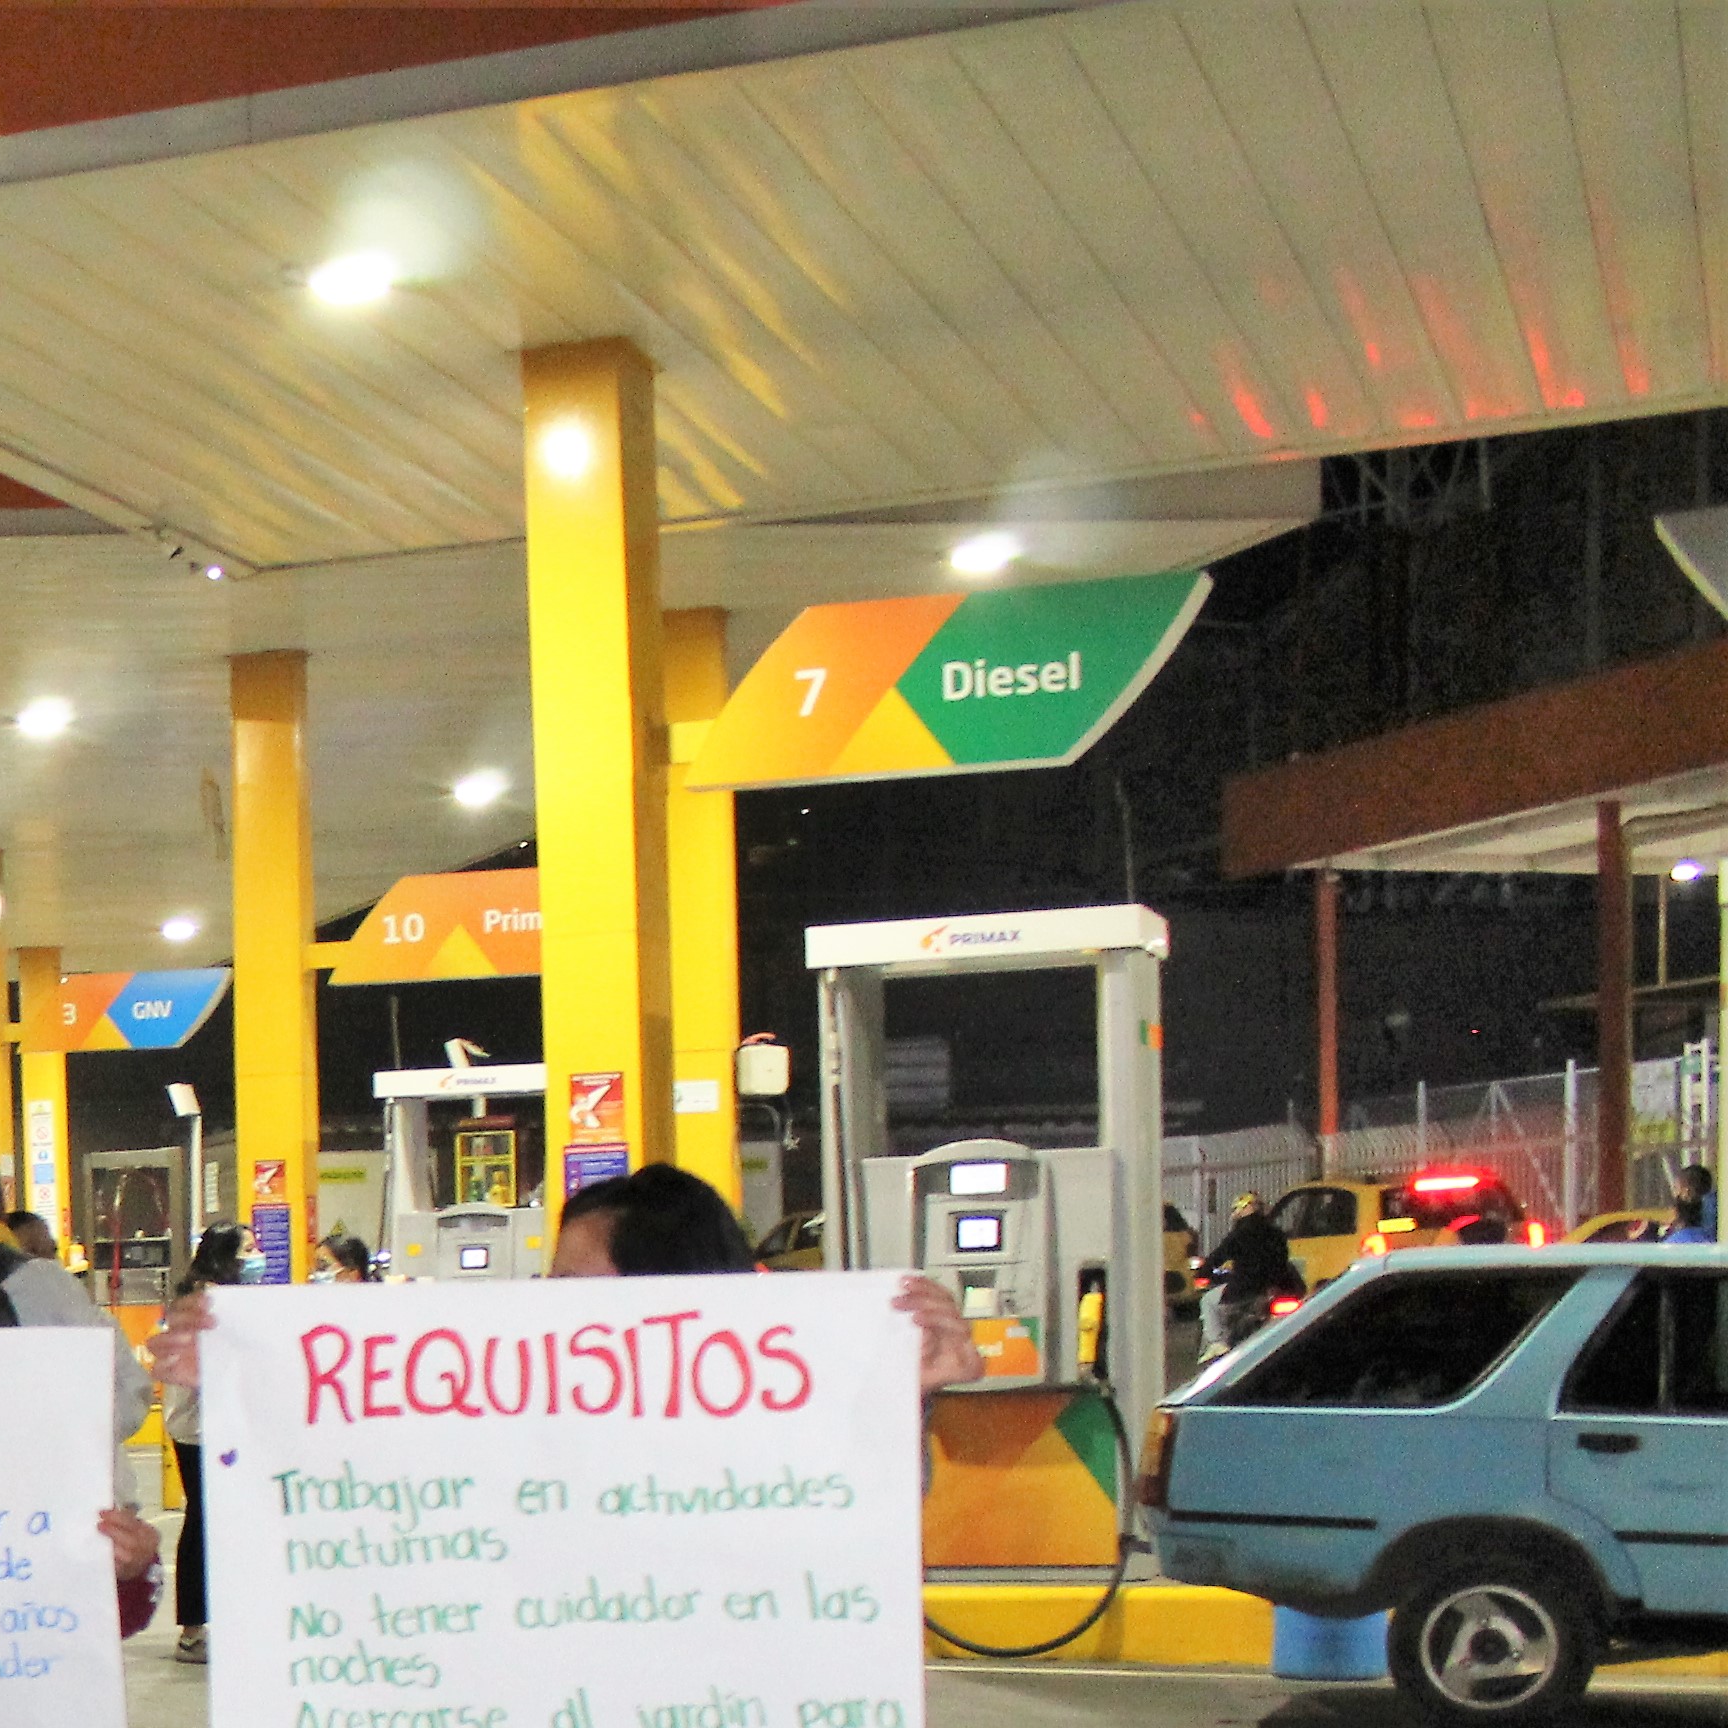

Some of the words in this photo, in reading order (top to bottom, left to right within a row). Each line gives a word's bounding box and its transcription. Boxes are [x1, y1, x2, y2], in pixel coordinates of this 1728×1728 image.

[795, 668, 828, 717] 7
[942, 651, 1082, 704] Diesel
[383, 913, 425, 944] 10
[950, 930, 1022, 945] PRIMAX
[62, 1003, 78, 1025] 3
[132, 1001, 172, 1019] GNV
[301, 1310, 813, 1426] REQUISITOS
[273, 1461, 476, 1531] Trabajar
[516, 1478, 568, 1516] en
[598, 1465, 855, 1518] actividades
[26, 1510, 51, 1536] a
[286, 1525, 510, 1574] nocturnas
[288, 1601, 342, 1642] No
[370, 1593, 480, 1638] tener
[515, 1576, 703, 1629] cuidador
[723, 1589, 777, 1621] en
[806, 1571, 880, 1624] las
[288, 1648, 441, 1690] noches
